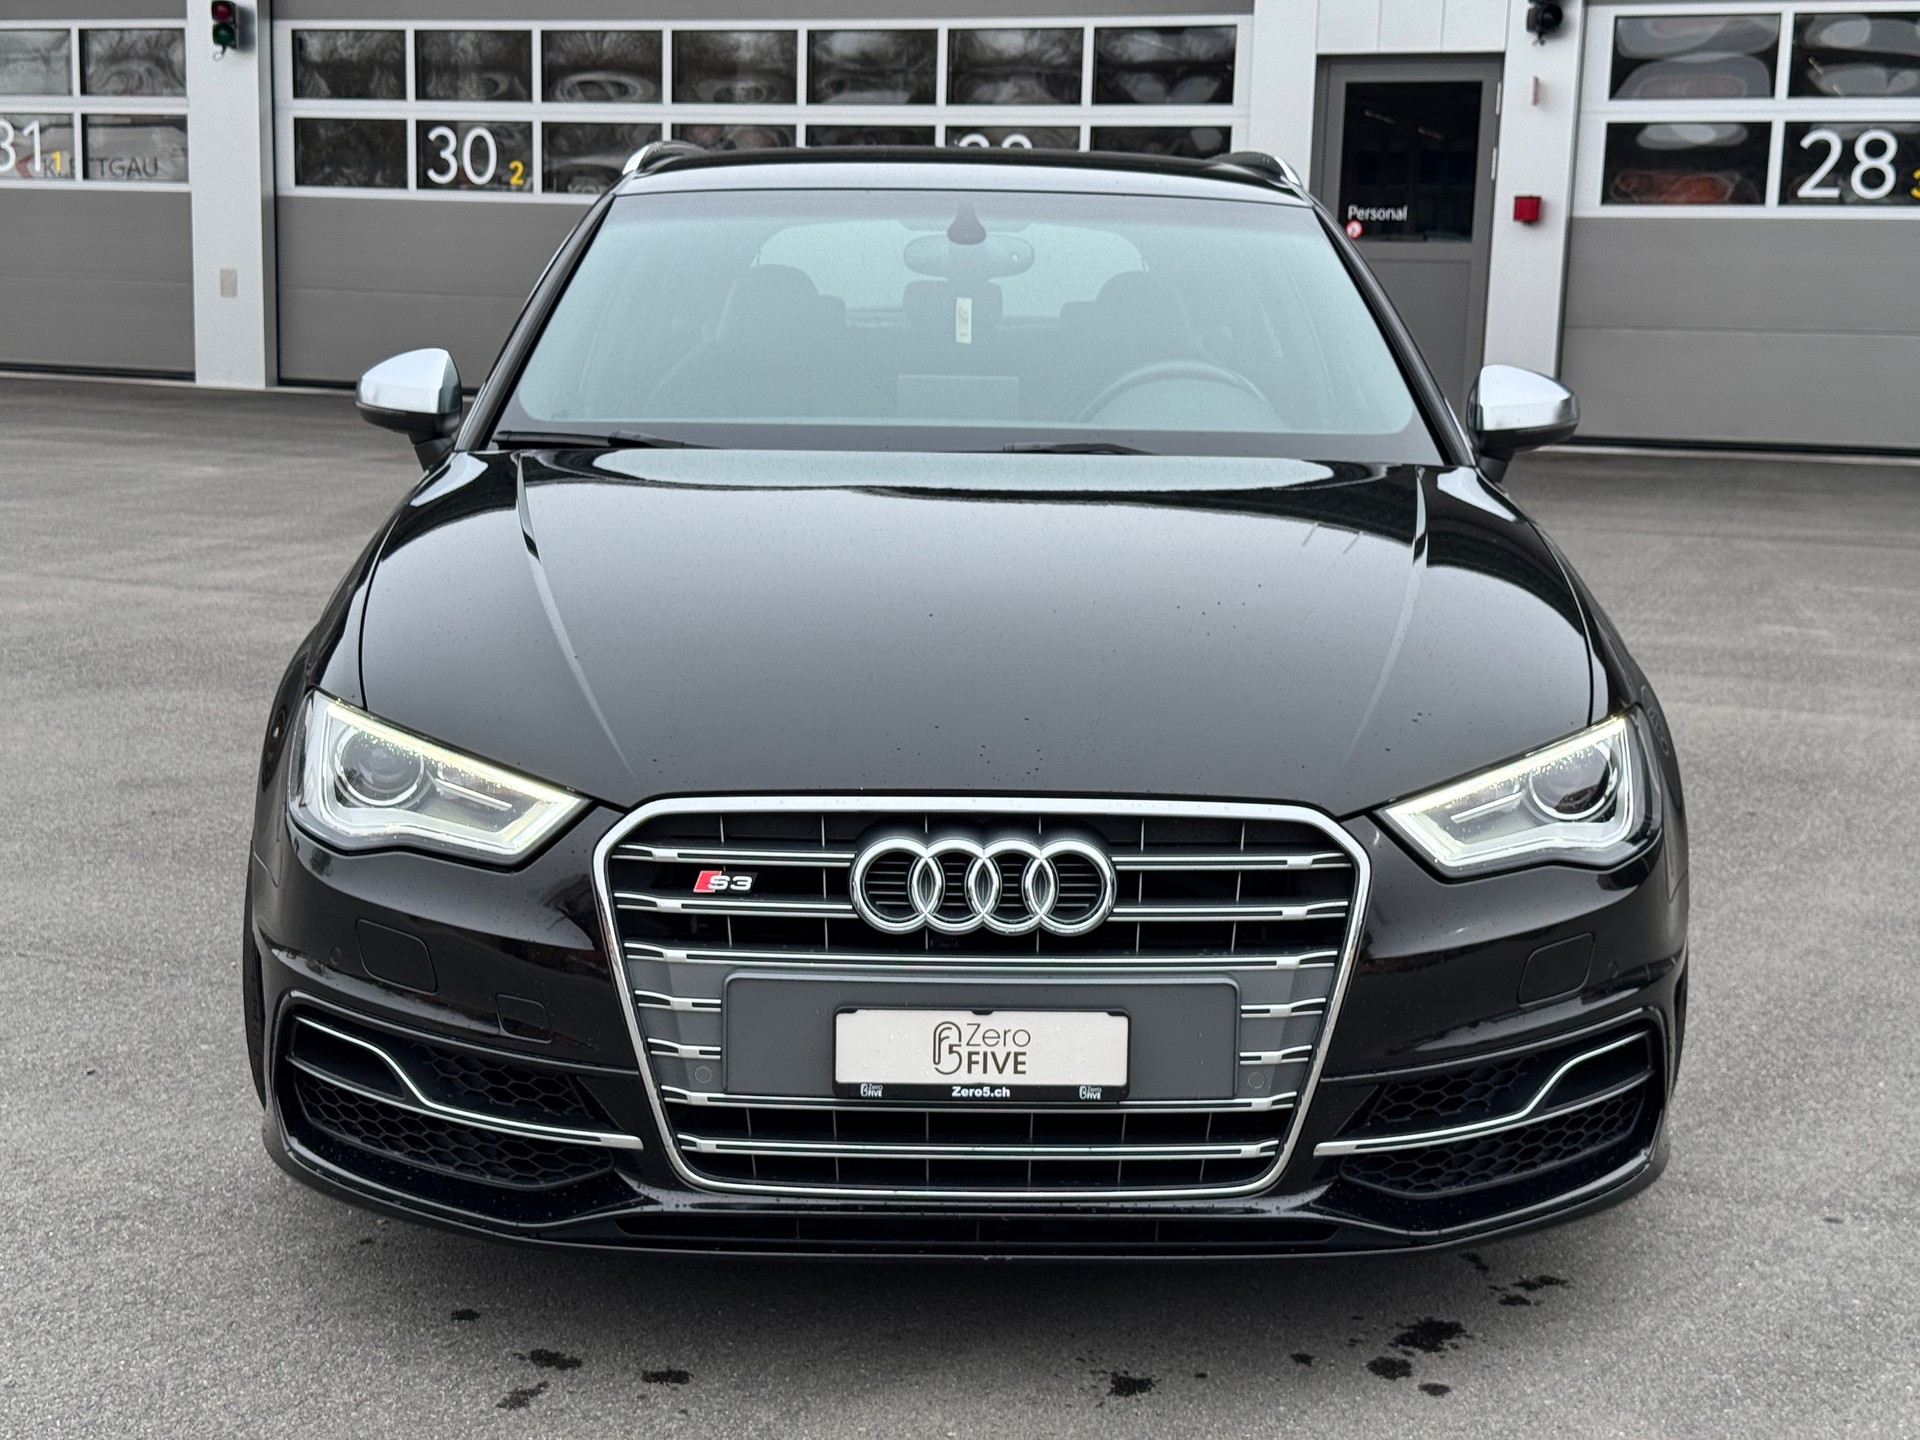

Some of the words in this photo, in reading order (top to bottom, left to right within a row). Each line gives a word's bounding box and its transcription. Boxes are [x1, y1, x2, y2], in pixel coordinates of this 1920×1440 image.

[427, 125, 497, 185] 30
[509, 160, 524, 186] 2
[1797, 128, 1898, 200] 28
[1347, 203, 1408, 221] Personal
[707, 875, 752, 891] S3
[966, 1023, 1031, 1047] Zero
[967, 1051, 1027, 1075] FIVE
[951, 1085, 1011, 1098] Zero5.ch
